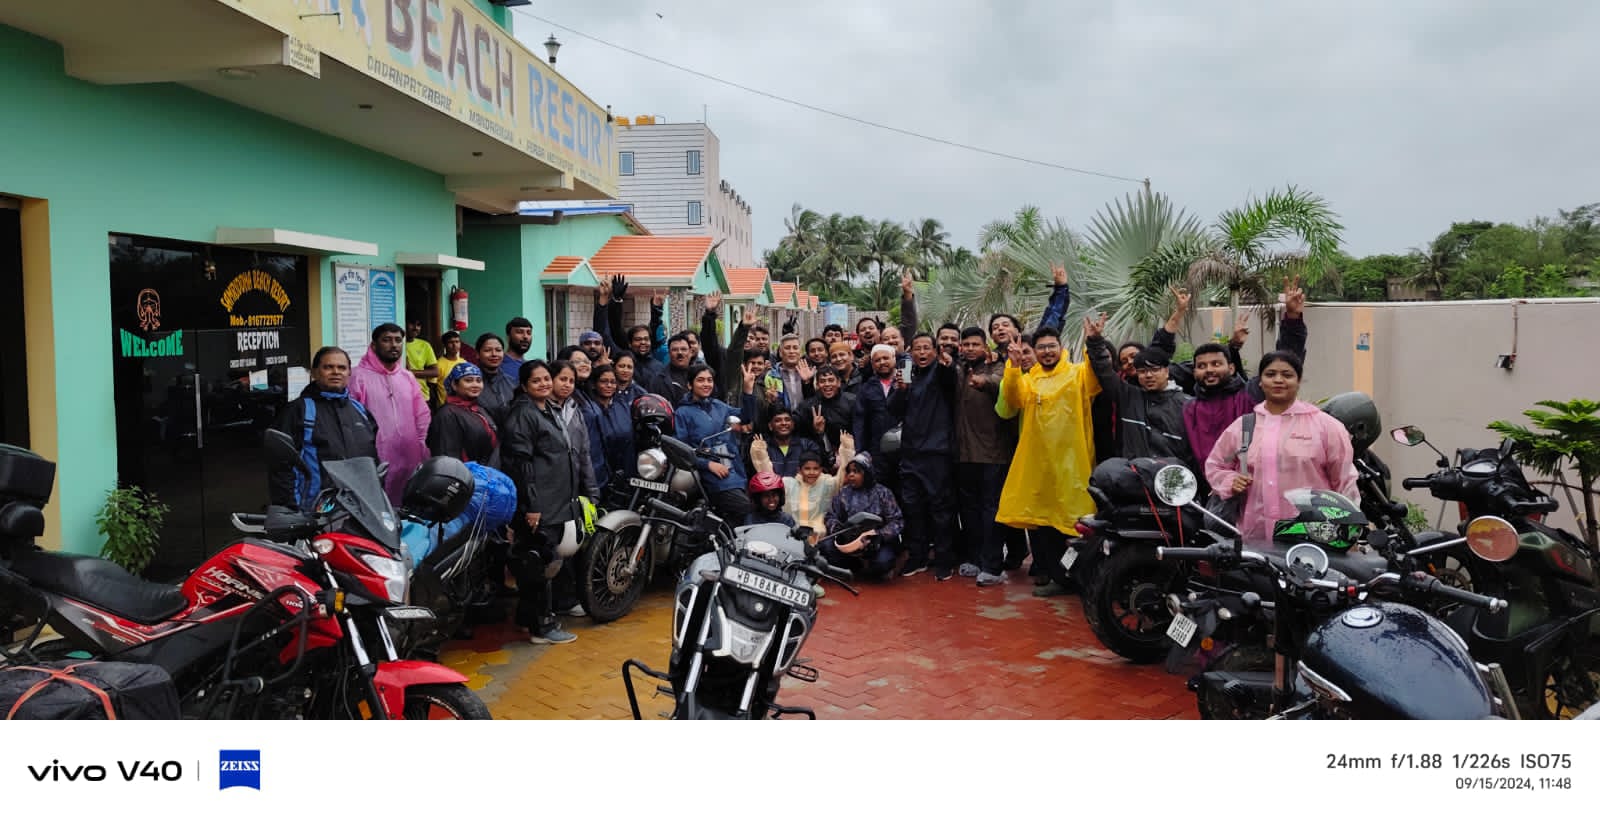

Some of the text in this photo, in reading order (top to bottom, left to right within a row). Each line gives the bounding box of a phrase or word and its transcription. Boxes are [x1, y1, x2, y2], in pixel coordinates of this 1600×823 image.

[386, 0, 613, 175] BEACH RESORT
[120, 328, 184, 358] WELCOME
[237, 330, 280, 352] RECEPTION
[202, 566, 265, 600] HORNE
[781, 586, 808, 604] 0326
